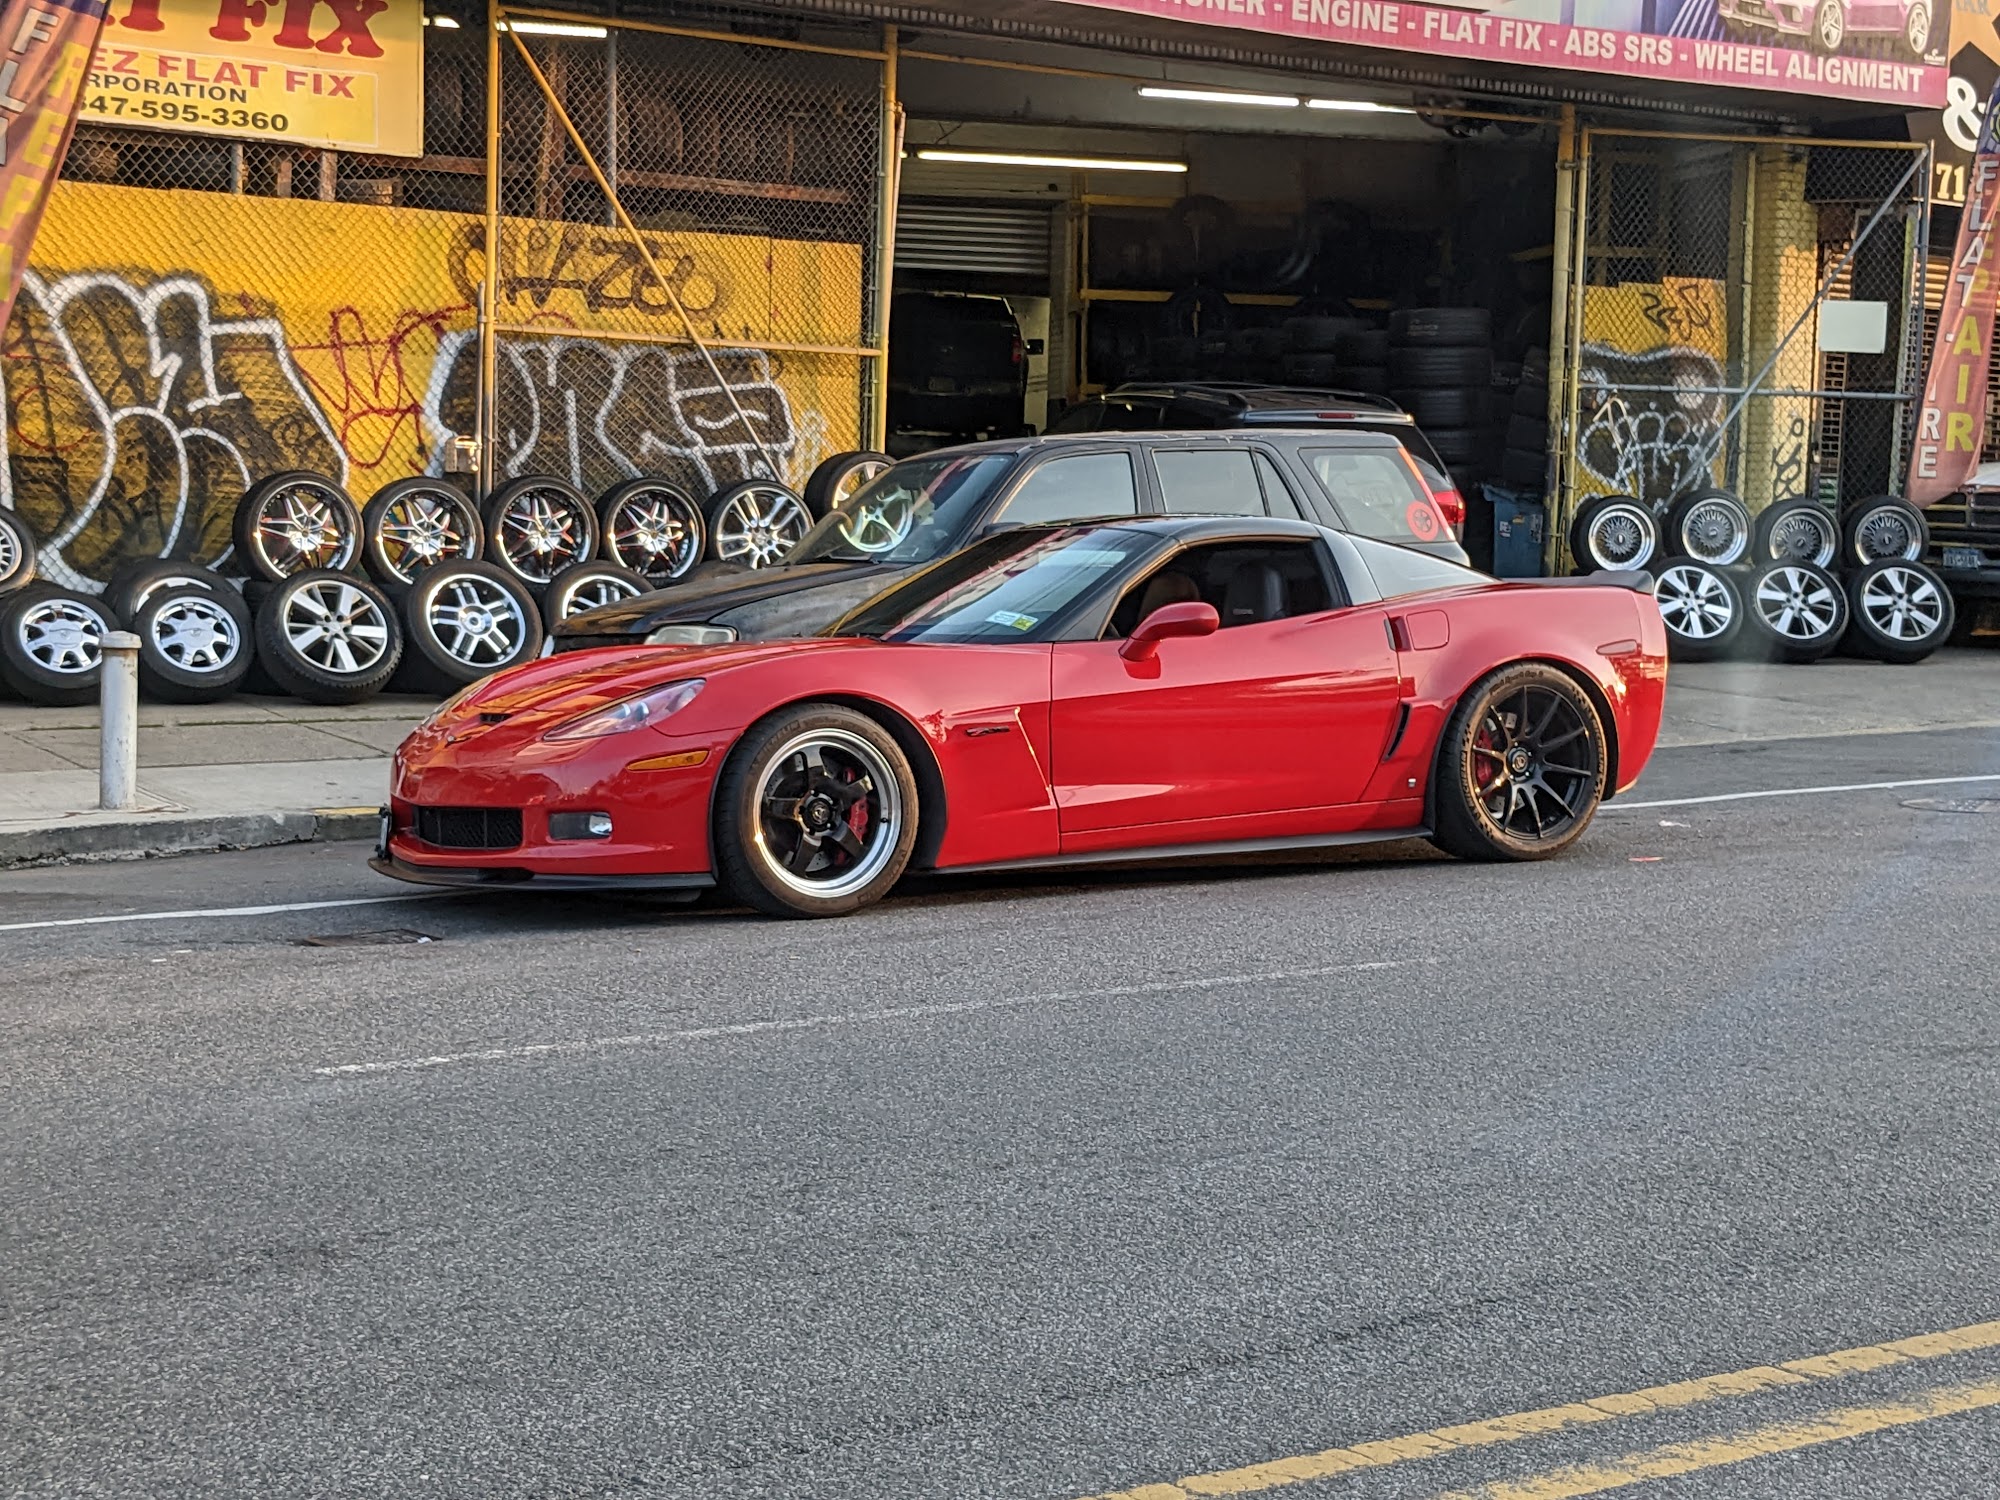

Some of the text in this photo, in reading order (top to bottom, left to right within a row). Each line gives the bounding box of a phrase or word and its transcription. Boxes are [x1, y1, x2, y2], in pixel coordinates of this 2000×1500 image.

[209, 0, 384, 58] FIX
[1291, 0, 1399, 34] ENGINE
[1424, 11, 1492, 45] FLAT
[1500, 20, 1542, 51] FIX
[1564, 29, 1616, 59] ABS
[1624, 36, 1673, 65] SRS
[1694, 43, 1779, 77] WHEEL
[1785, 53, 1925, 93] ALIGNMENT
[158, 54, 267, 88] FLAT
[285, 70, 355, 99] FIX
[1936, 163, 1966, 201] 71
